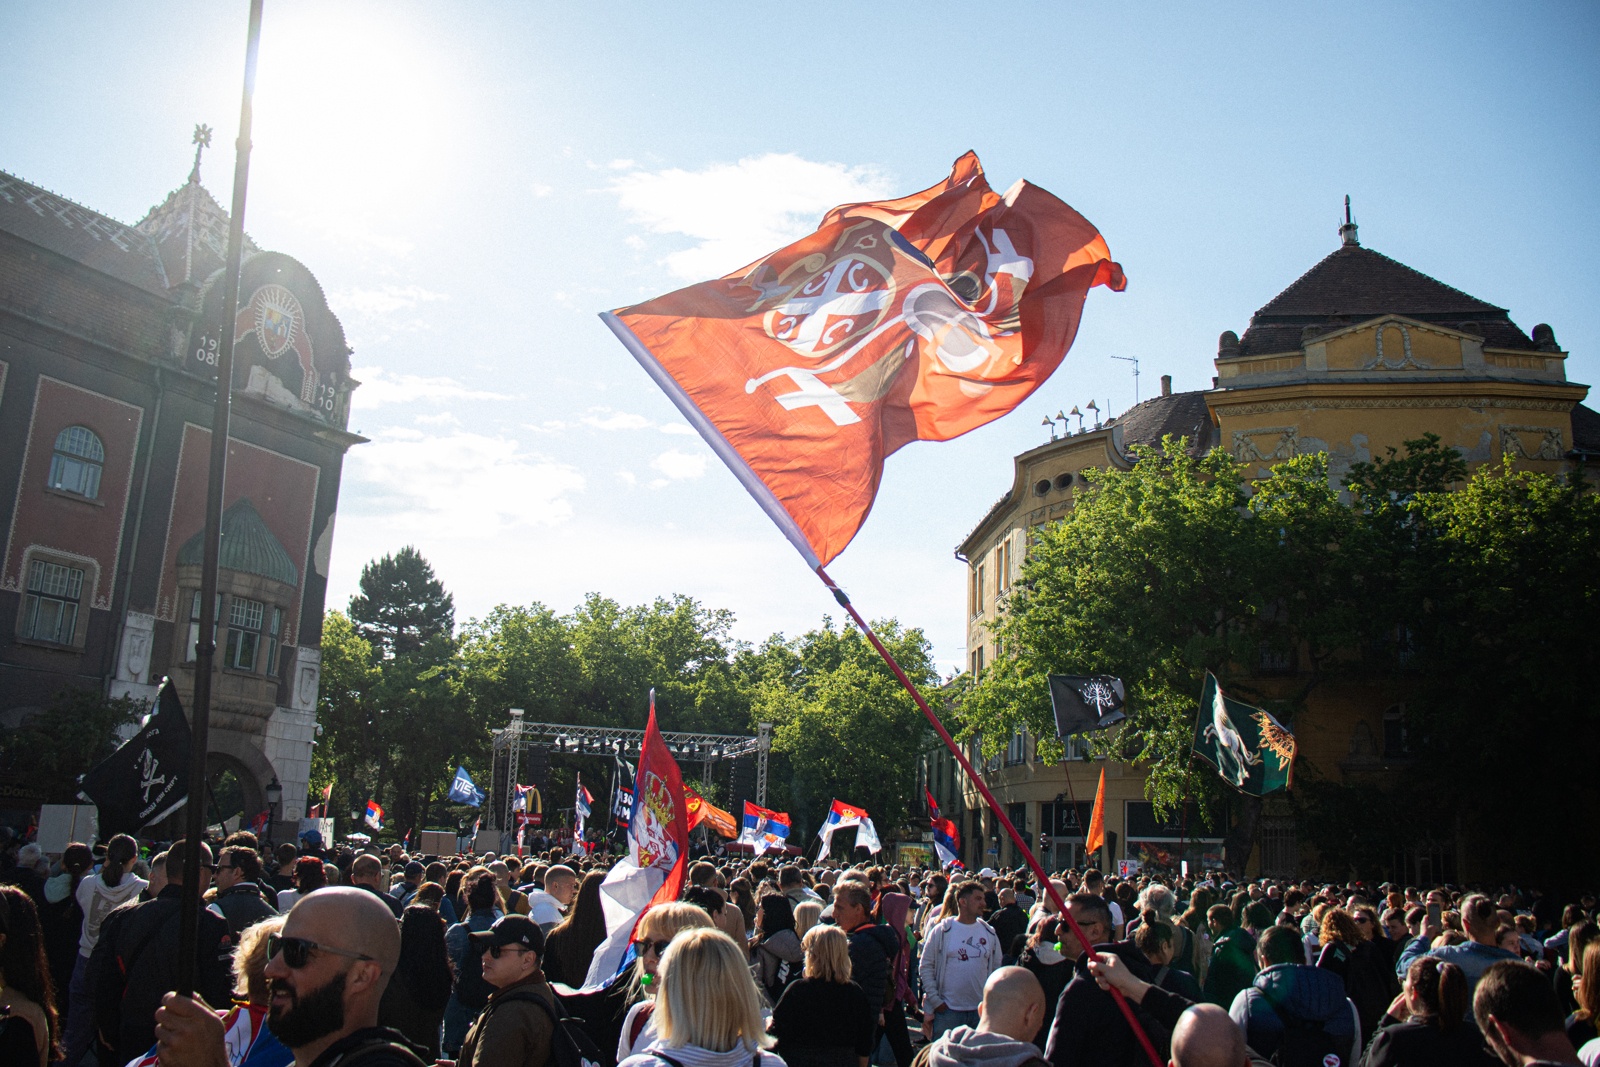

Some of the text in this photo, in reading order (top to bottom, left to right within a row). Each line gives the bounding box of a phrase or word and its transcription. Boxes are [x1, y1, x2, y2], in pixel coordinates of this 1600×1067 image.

[199, 335, 218, 351] 19
[196, 348, 215, 366] 08
[320, 383, 335, 398] 19
[317, 396, 333, 411] 10
[454, 776, 475, 796] VTS
